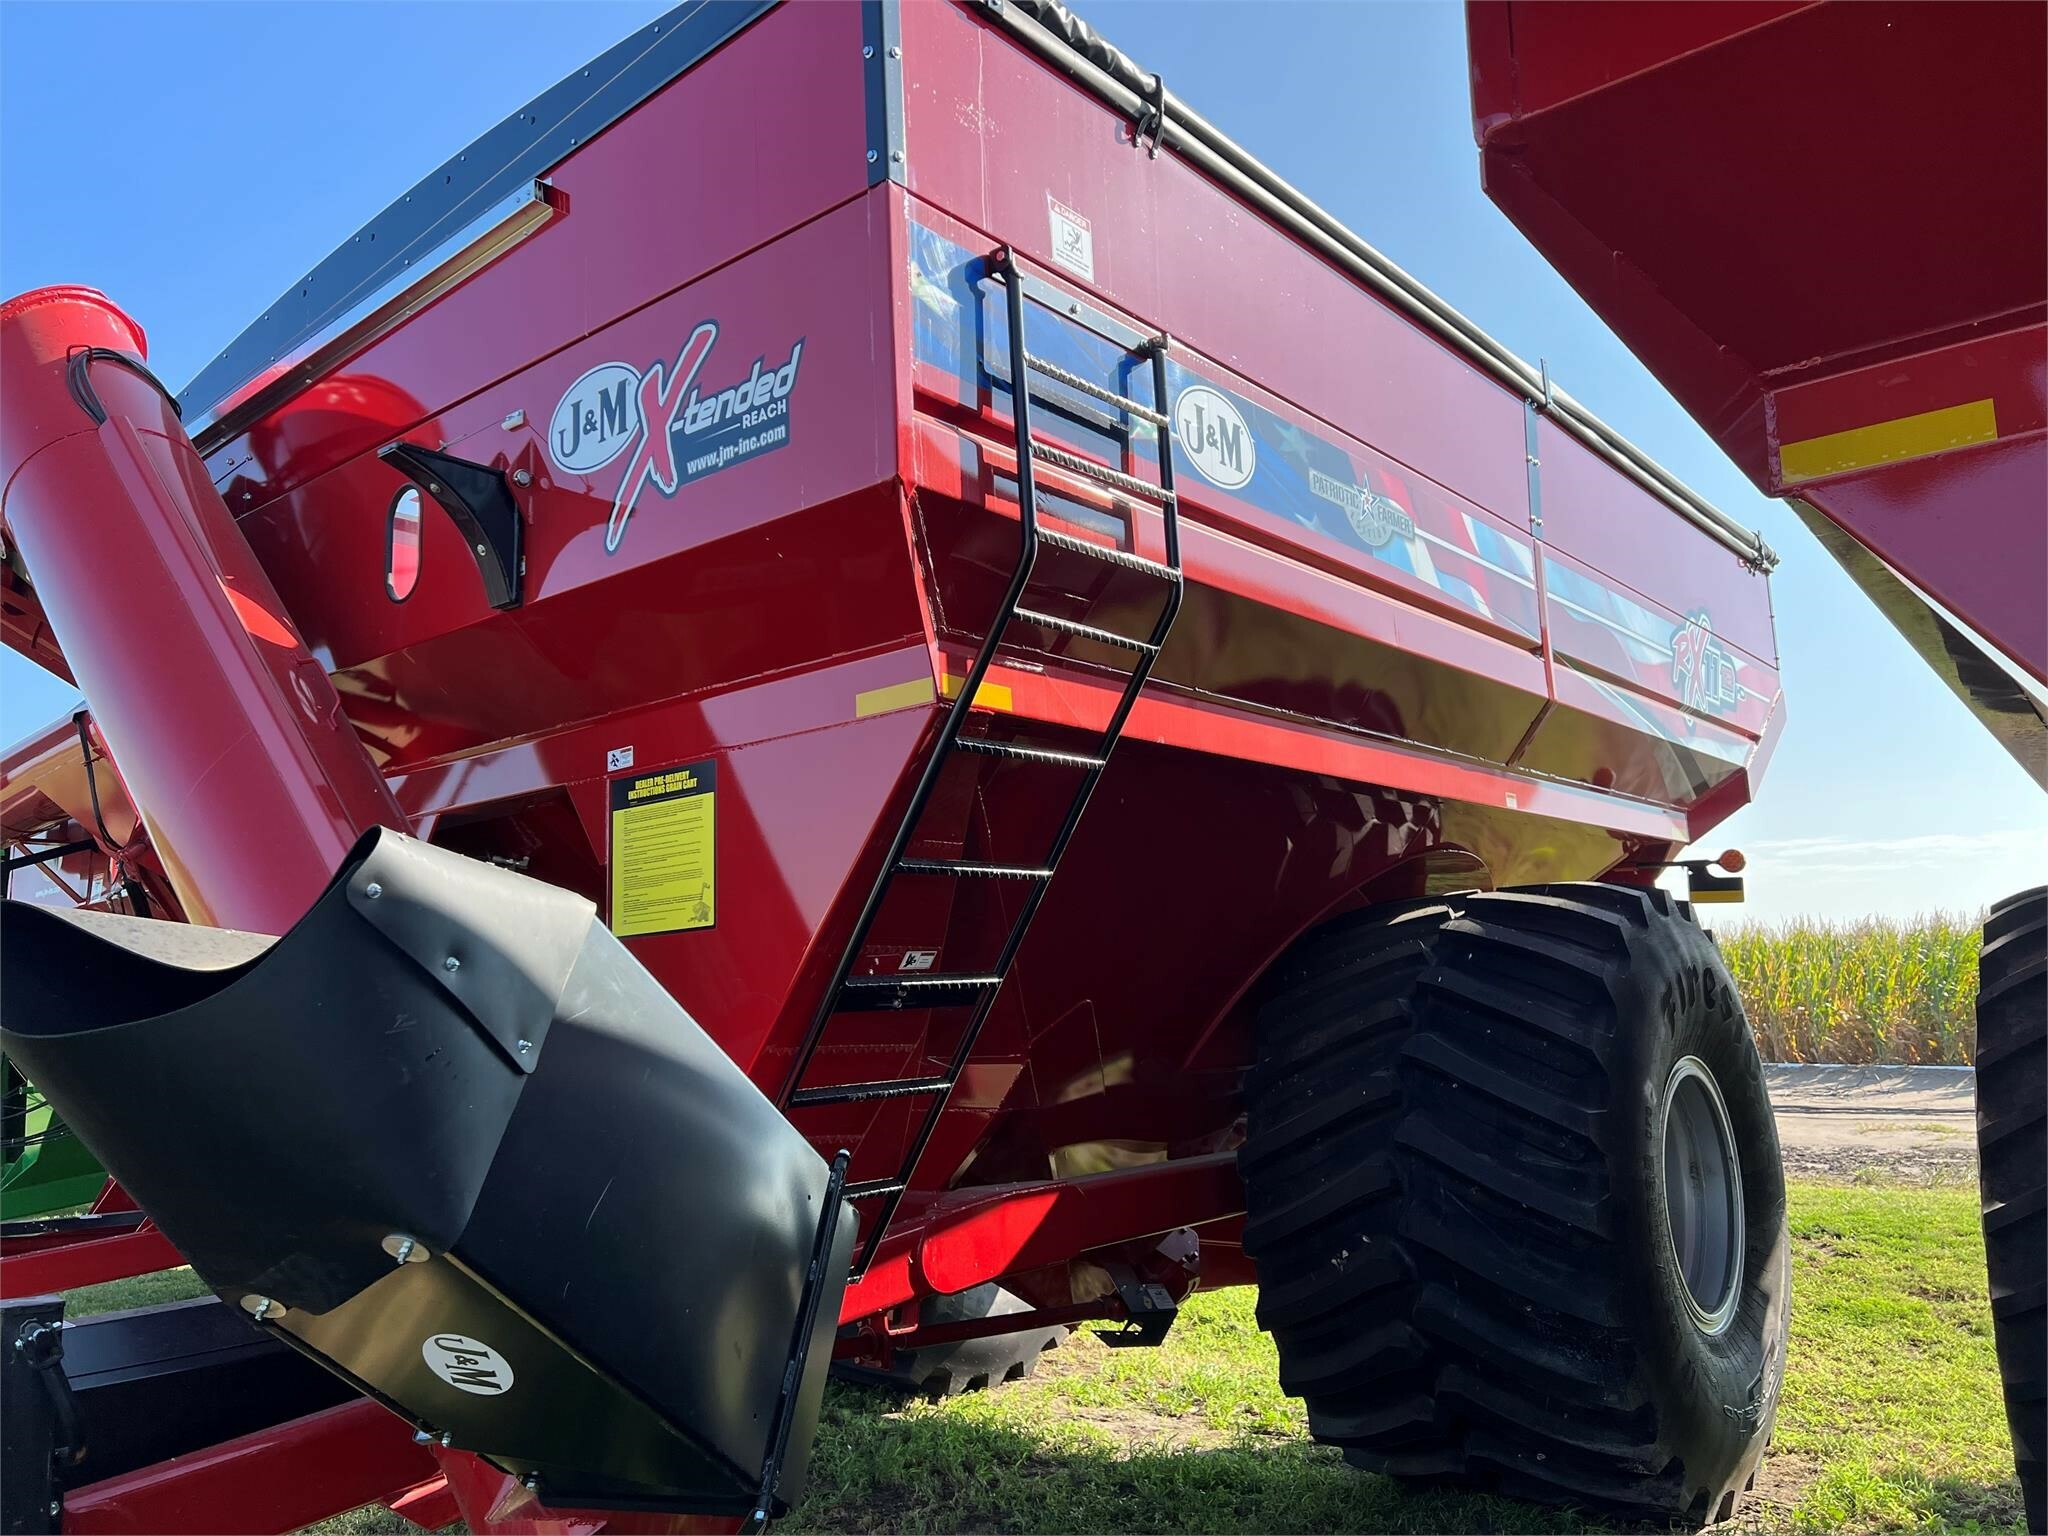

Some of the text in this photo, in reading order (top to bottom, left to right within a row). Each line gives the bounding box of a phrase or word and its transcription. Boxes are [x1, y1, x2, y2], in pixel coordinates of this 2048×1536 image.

[1060, 206, 1087, 228] DANGER
[558, 378, 629, 458] J&M
[742, 398, 787, 430] REACH
[1184, 402, 1244, 475] J&M
[686, 424, 786, 475] www.jm-inc.com
[1312, 473, 1411, 533] PATRIOTIC FARMER
[627, 778, 698, 800] INSTRUCTIONS GRAIN CART
[635, 770, 690, 790] DEALER PRE-DELIVERY
[434, 1337, 503, 1391] J&M
